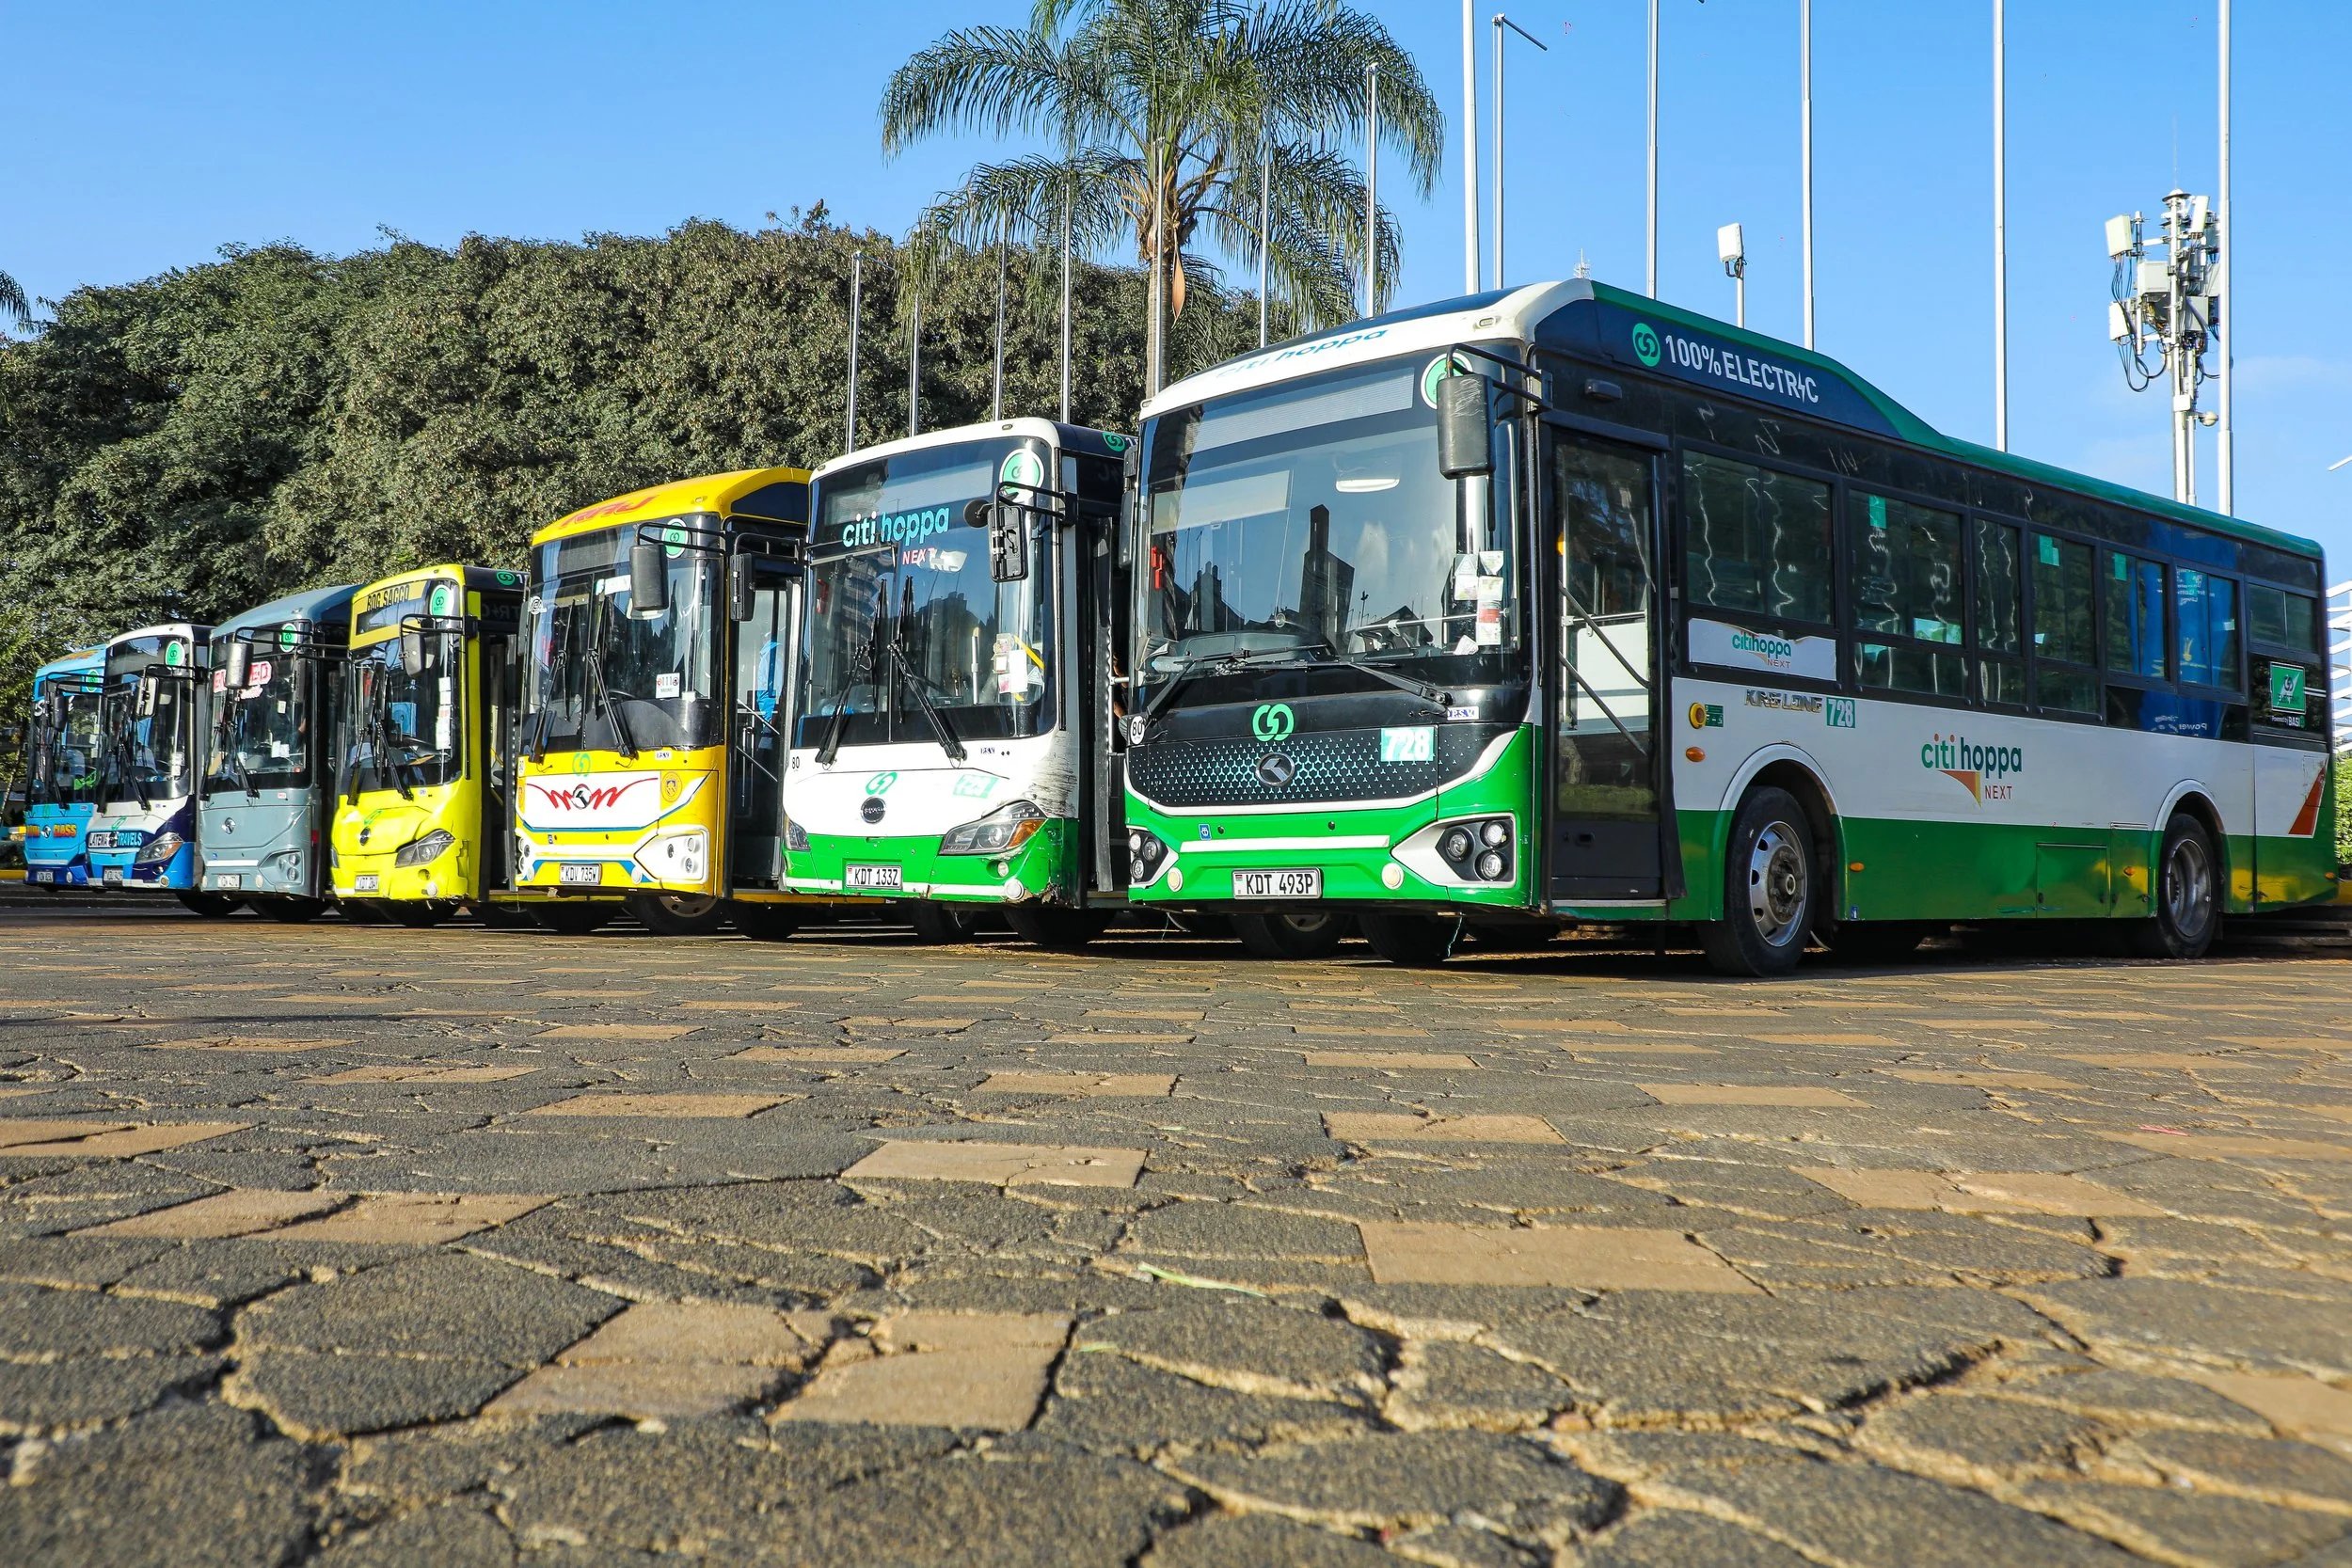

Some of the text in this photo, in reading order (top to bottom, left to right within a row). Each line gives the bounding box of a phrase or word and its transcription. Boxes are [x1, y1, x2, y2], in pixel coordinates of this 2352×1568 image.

[1275, 329, 1389, 362] hoppa
[1665, 335, 1820, 404] 100% ELECTRIC
[843, 508, 949, 547] citi hoppa
[902, 547, 936, 566] NEXT
[383, 584, 410, 608] SACCO
[1767, 659, 1791, 669] NEXT
[1782, 694, 1823, 714] LONG
[1828, 699, 1854, 728] 728
[1132, 721, 1143, 736] 80
[1385, 728, 1431, 761] 728
[791, 756, 801, 769] 80
[1921, 734, 2022, 779] citi hoppa
[1984, 785, 2012, 800] NEXT
[117, 832, 142, 847] TRAVELS
[854, 868, 898, 886] KDT 133Z
[1246, 874, 1313, 895] KDT 493P
